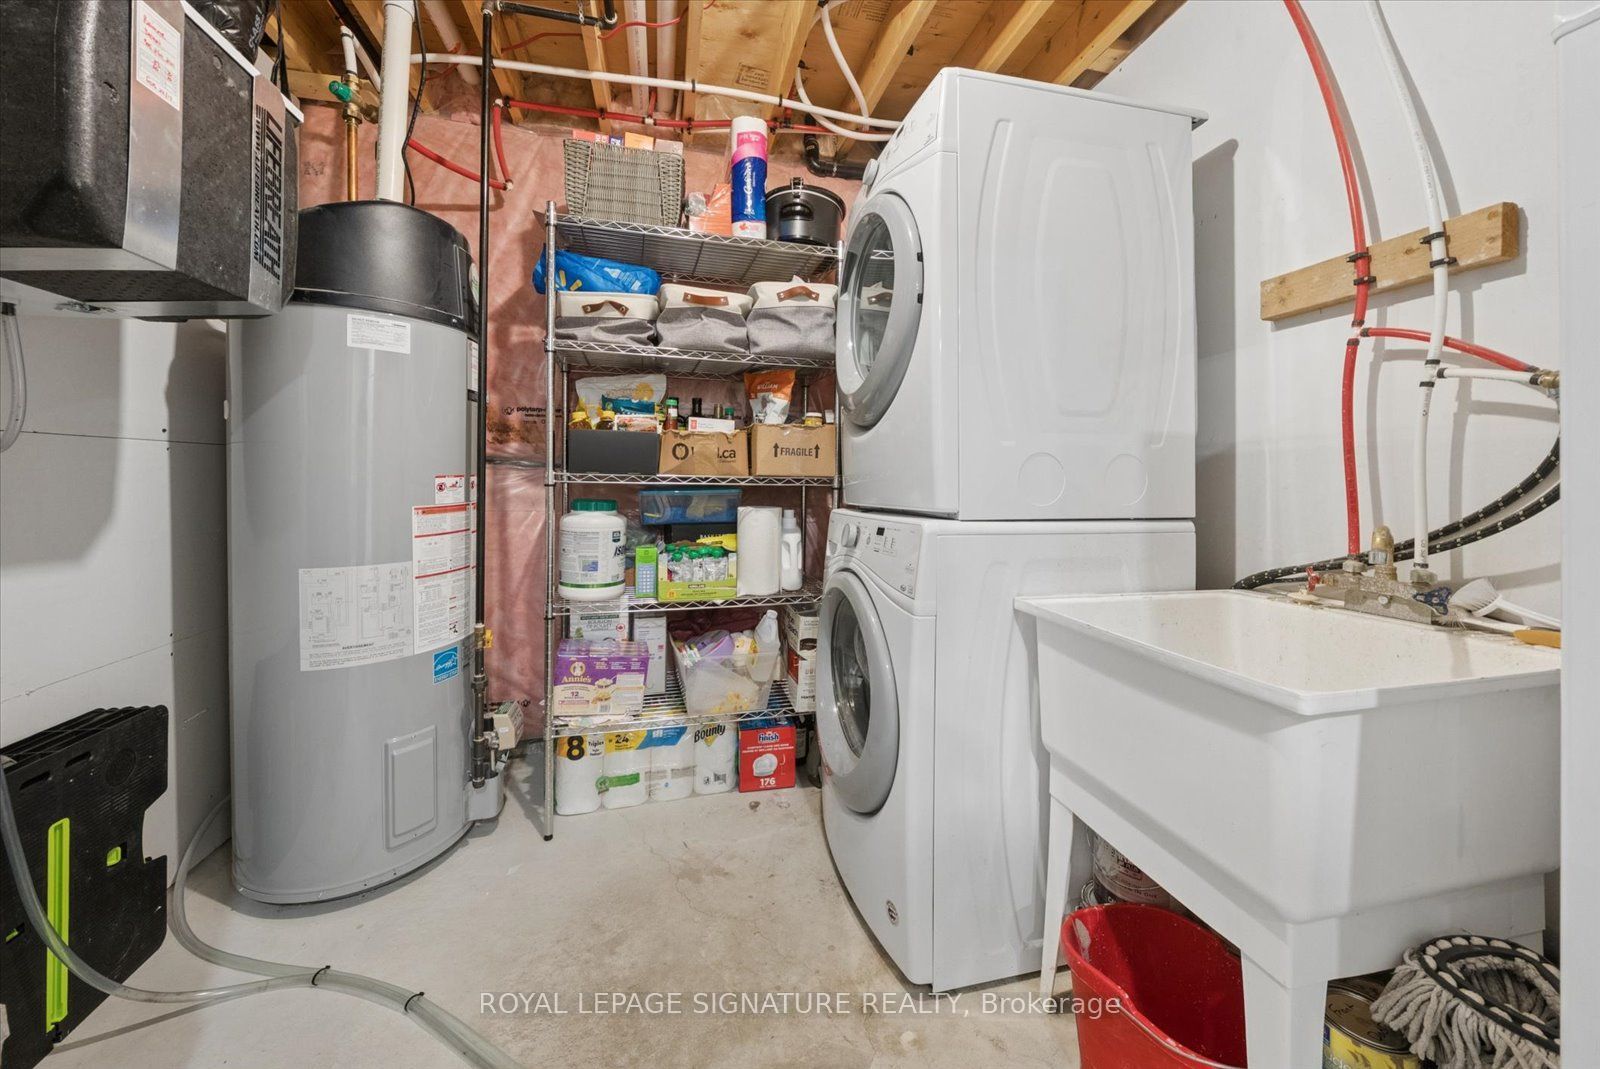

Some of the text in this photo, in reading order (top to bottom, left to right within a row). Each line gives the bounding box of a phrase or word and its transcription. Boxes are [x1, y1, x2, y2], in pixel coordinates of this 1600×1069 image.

[253, 118, 262, 262] WWW.LIFEBREATH.COM
[263, 111, 283, 281] LIFEBREATH
[780, 447, 813, 457] FRAGILE
[561, 675, 592, 684] Annie's
[694, 724, 726, 743] Bounty
[758, 733, 779, 742] Finish
[567, 735, 585, 761] 8
[759, 778, 776, 786] 176
